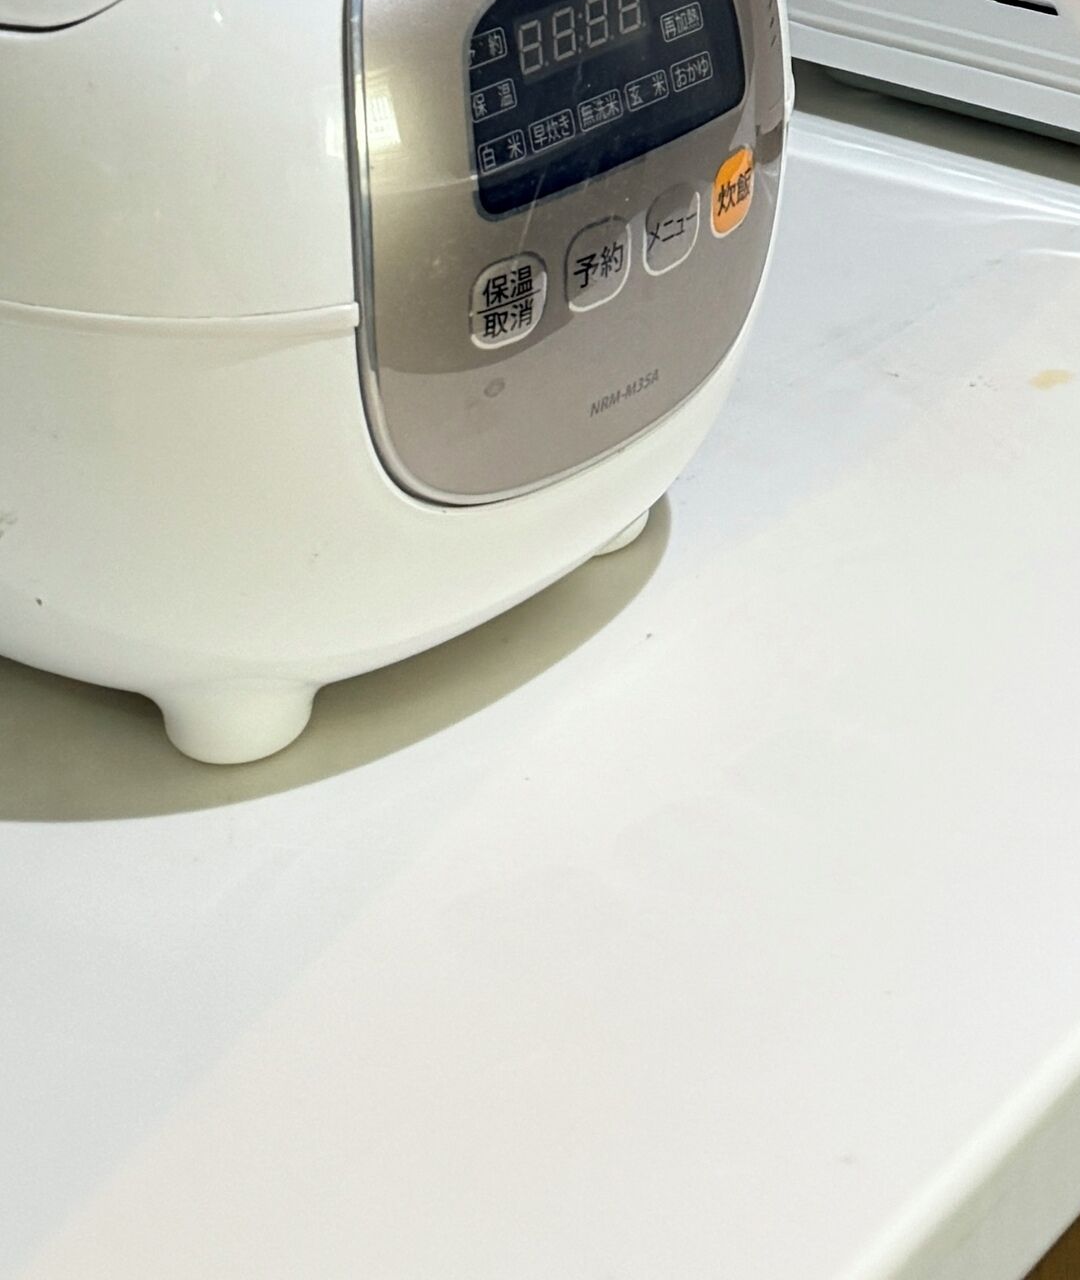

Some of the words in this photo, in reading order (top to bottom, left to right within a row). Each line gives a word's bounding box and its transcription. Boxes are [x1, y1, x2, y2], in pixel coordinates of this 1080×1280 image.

[664, 8, 700, 41] 再加熱
[472, 82, 514, 117] 保温
[482, 134, 524, 171] 白米
[532, 114, 573, 147] 早炊き
[580, 96, 621, 126] 無洗米
[629, 75, 668, 107] 玄米
[674, 57, 710, 89] おかゆ
[717, 167, 752, 217] 炊飯
[646, 211, 698, 251] メニュー
[574, 242, 624, 289] 予約
[483, 266, 533, 307] 保温
[483, 299, 535, 338] 取消
